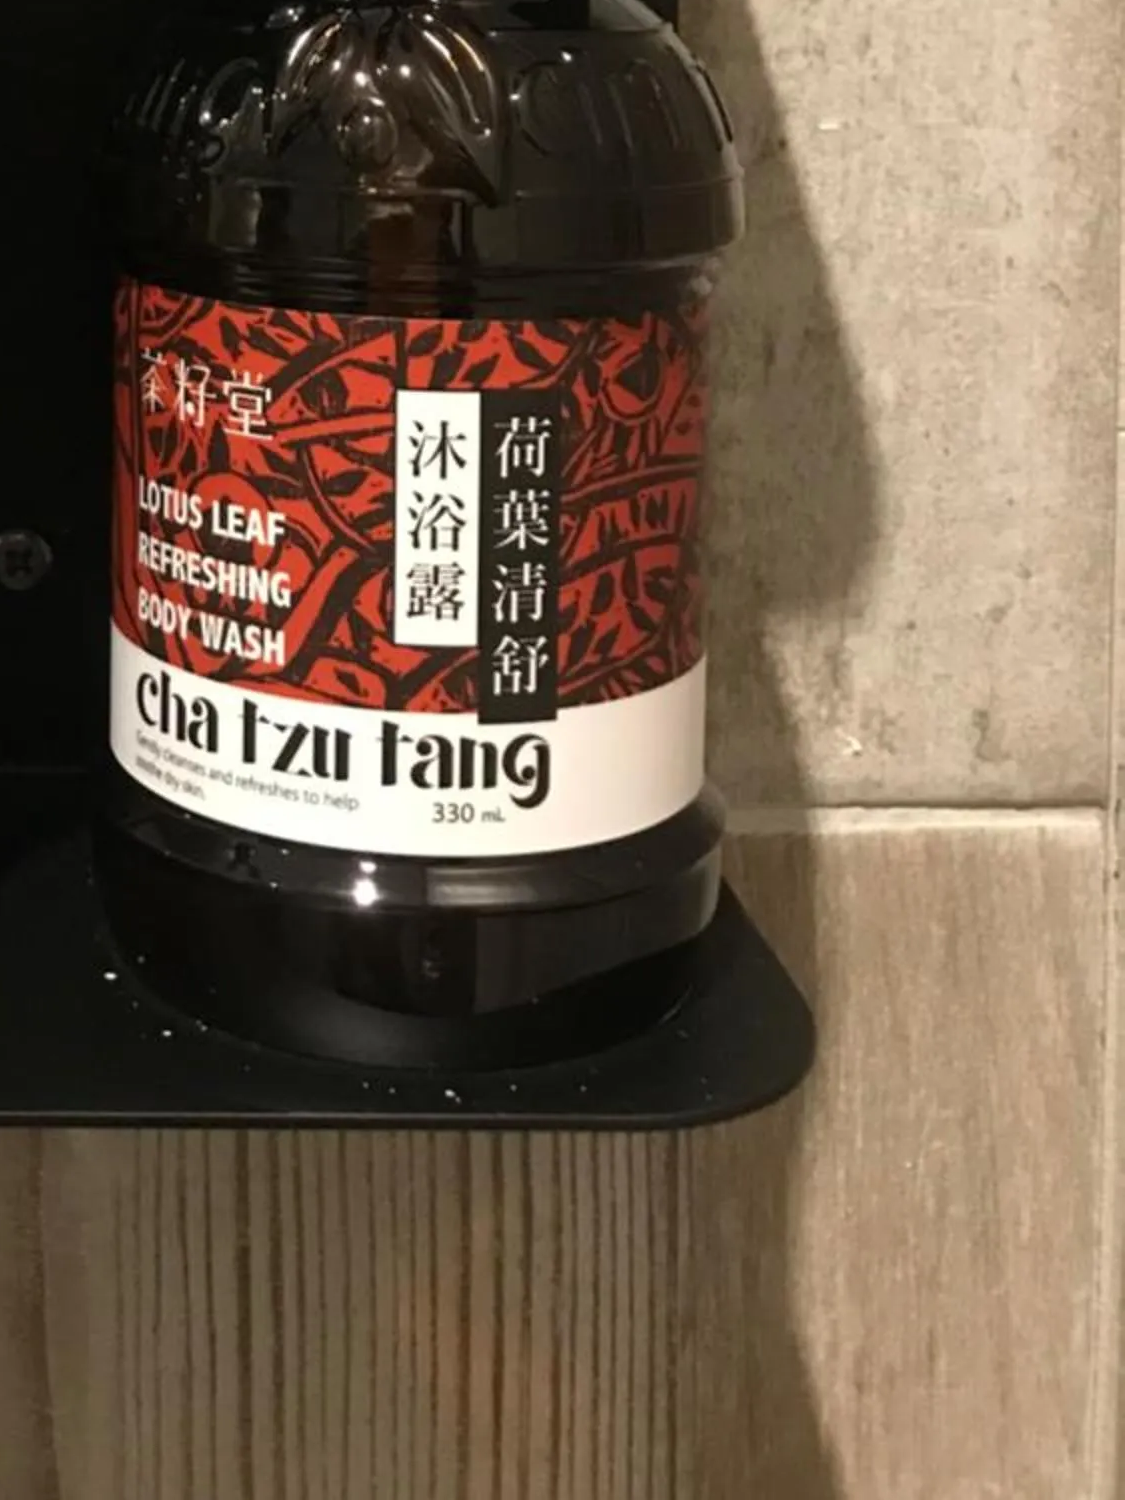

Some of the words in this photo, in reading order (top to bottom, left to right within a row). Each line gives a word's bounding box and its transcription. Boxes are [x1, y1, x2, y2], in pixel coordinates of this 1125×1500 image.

[139, 346, 274, 440] 茶籽堂
[138, 472, 204, 531] LOTUS
[211, 498, 287, 548] LEAF
[406, 419, 468, 621] 沐浴露
[138, 530, 291, 609] REFRESHING
[491, 415, 552, 697] 荷葉清舒
[137, 585, 192, 641] BODY
[199, 611, 286, 667] WASH
[136, 669, 219, 753] cha
[238, 697, 352, 782] tzu
[376, 719, 552, 810] tang
[208, 767, 234, 787] and
[235, 774, 299, 802] refreshes
[303, 788, 321, 806] to
[323, 791, 361, 813] help
[431, 801, 475, 824] 330
[481, 805, 506, 824] mL
